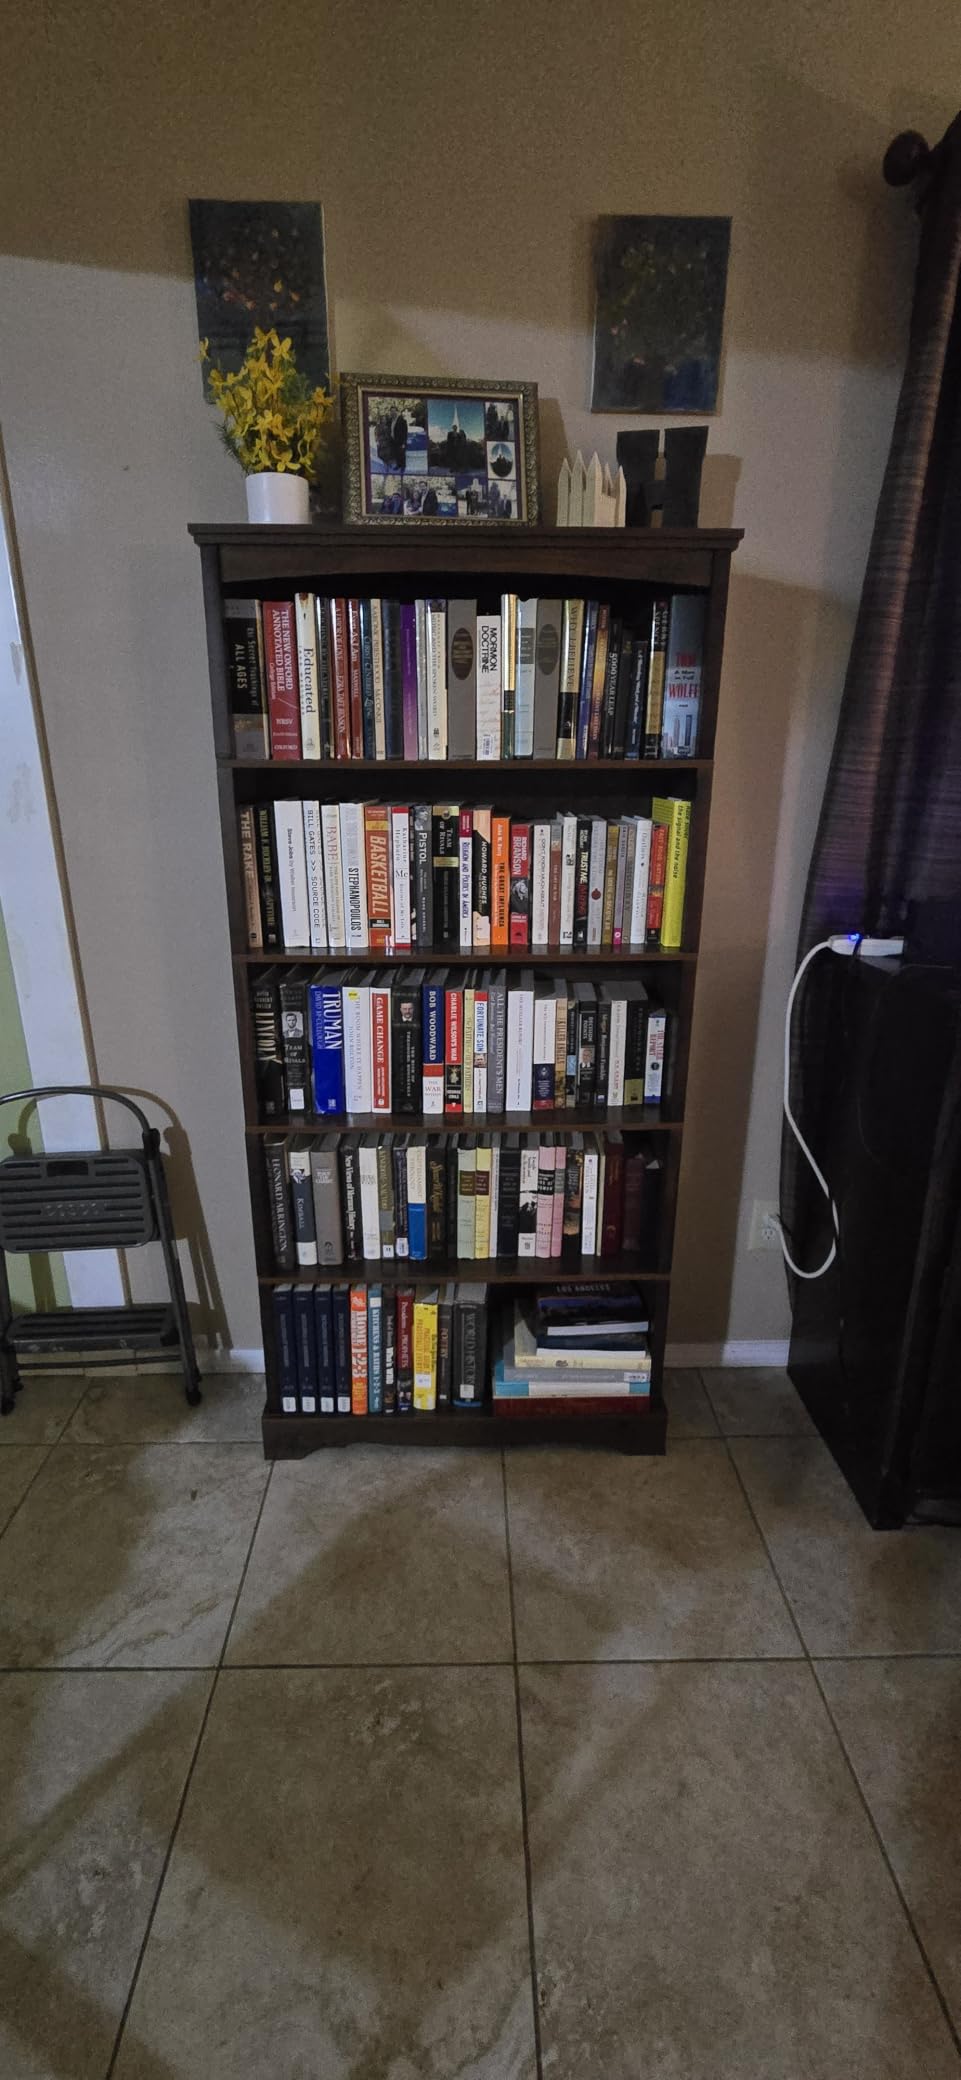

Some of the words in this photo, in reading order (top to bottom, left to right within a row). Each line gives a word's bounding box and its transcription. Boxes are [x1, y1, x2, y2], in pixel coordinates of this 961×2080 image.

[282, 610, 290, 628] THE
[234, 644, 246, 663] ALL
[272, 610, 284, 665] ANNOTATED
[283, 630, 292, 653] NEW
[481, 625, 489, 674] DOCTRINE
[236, 665, 247, 689] AGES
[276, 667, 285, 691] BIBLE
[284, 653, 293, 690] OXFORD
[610, 653, 618, 675] 5000
[303, 648, 316, 713] Educated
[240, 812, 250, 840] THE
[674, 817, 682, 836] signal
[326, 826, 338, 861] BABE
[419, 832, 428, 864] PISTOL
[512, 836, 522, 875] BRANSON
[242, 843, 254, 878] RAKE
[370, 835, 388, 915] BASKETBALL
[311, 876, 319, 906] SOURCE
[348, 867, 362, 931] STEPHANOPOULOS
[314, 991, 322, 1009] DAVID
[496, 992, 504, 1008] ALL
[322, 991, 342, 1050] TRUMAN
[476, 1003, 485, 1038] FORTUNATE
[496, 1010, 504, 1026] THE
[557, 1020, 566, 1042] KILLER
[256, 1012, 282, 1064] LINCOLN
[476, 1039, 484, 1052] SON
[557, 1043, 565, 1064] ANGELS
[272, 1159, 284, 1201] LEONARD
[276, 1202, 287, 1252] ARRINGTON
[346, 1211, 355, 1230] History
[356, 1311, 367, 1345] HOME
[372, 1309, 380, 1344] KITCHENS
[464, 1313, 475, 1349] WORLD
[440, 1328, 448, 1359] POETRY
